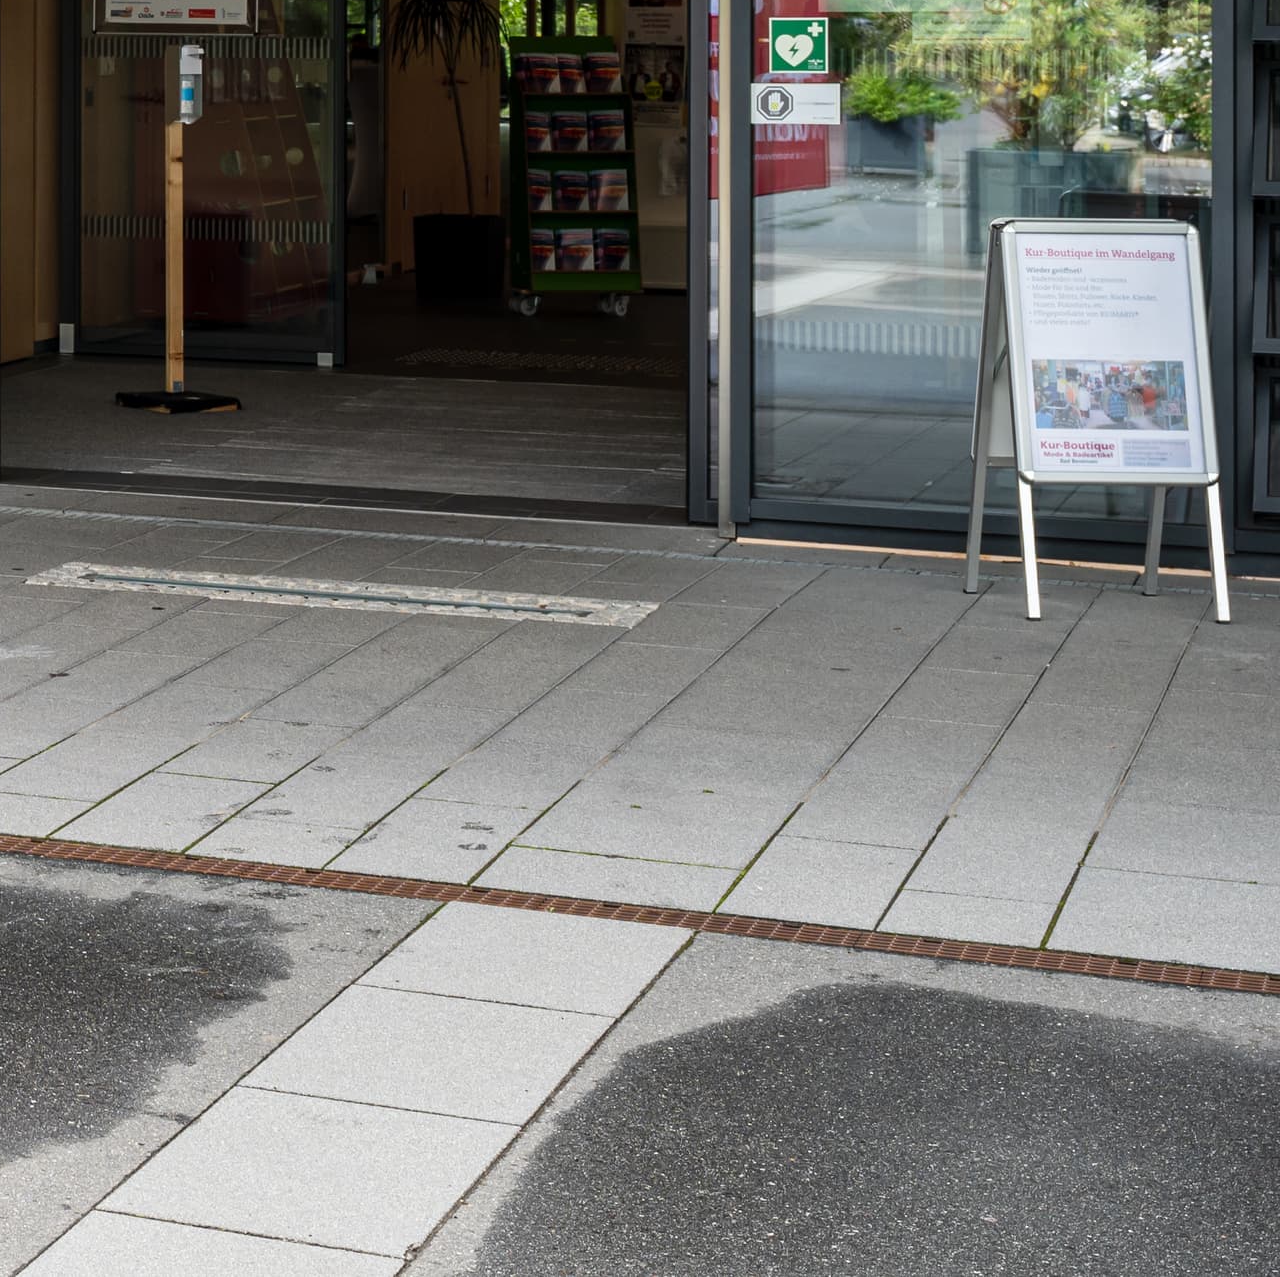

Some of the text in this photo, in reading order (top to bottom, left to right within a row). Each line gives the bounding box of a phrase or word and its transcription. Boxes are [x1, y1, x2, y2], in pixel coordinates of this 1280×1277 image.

[1024, 247, 1176, 262] Kur-Boutique im Wandelgang
[1040, 440, 1115, 452] Kur-Boutique
